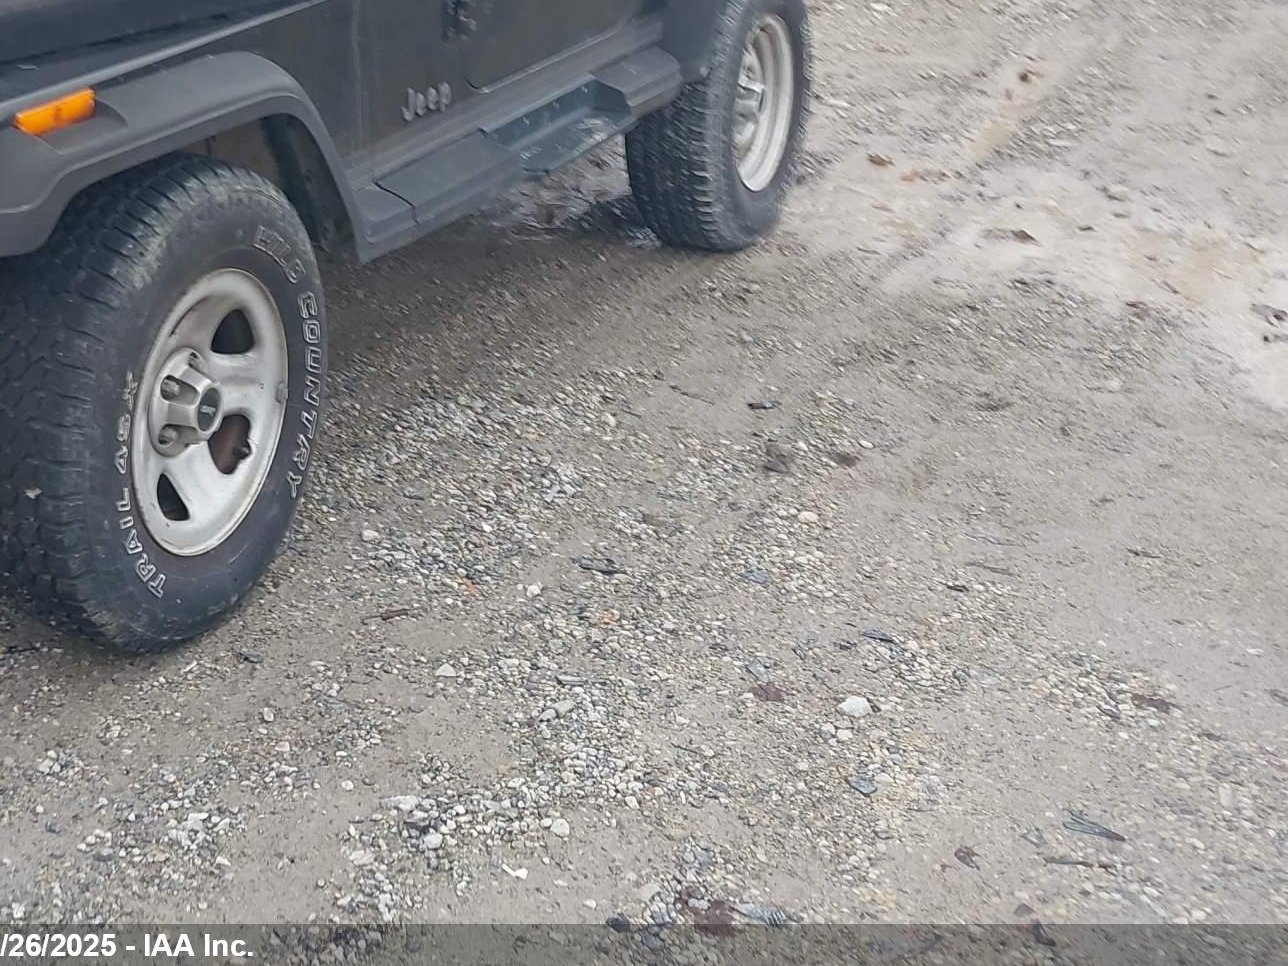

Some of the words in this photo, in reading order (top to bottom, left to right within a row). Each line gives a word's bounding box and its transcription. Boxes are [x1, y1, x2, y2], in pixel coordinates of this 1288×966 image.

[400, 81, 452, 122] Jeep
[287, 291, 321, 499] COUNTRY
[116, 487, 166, 599] TRAIL
